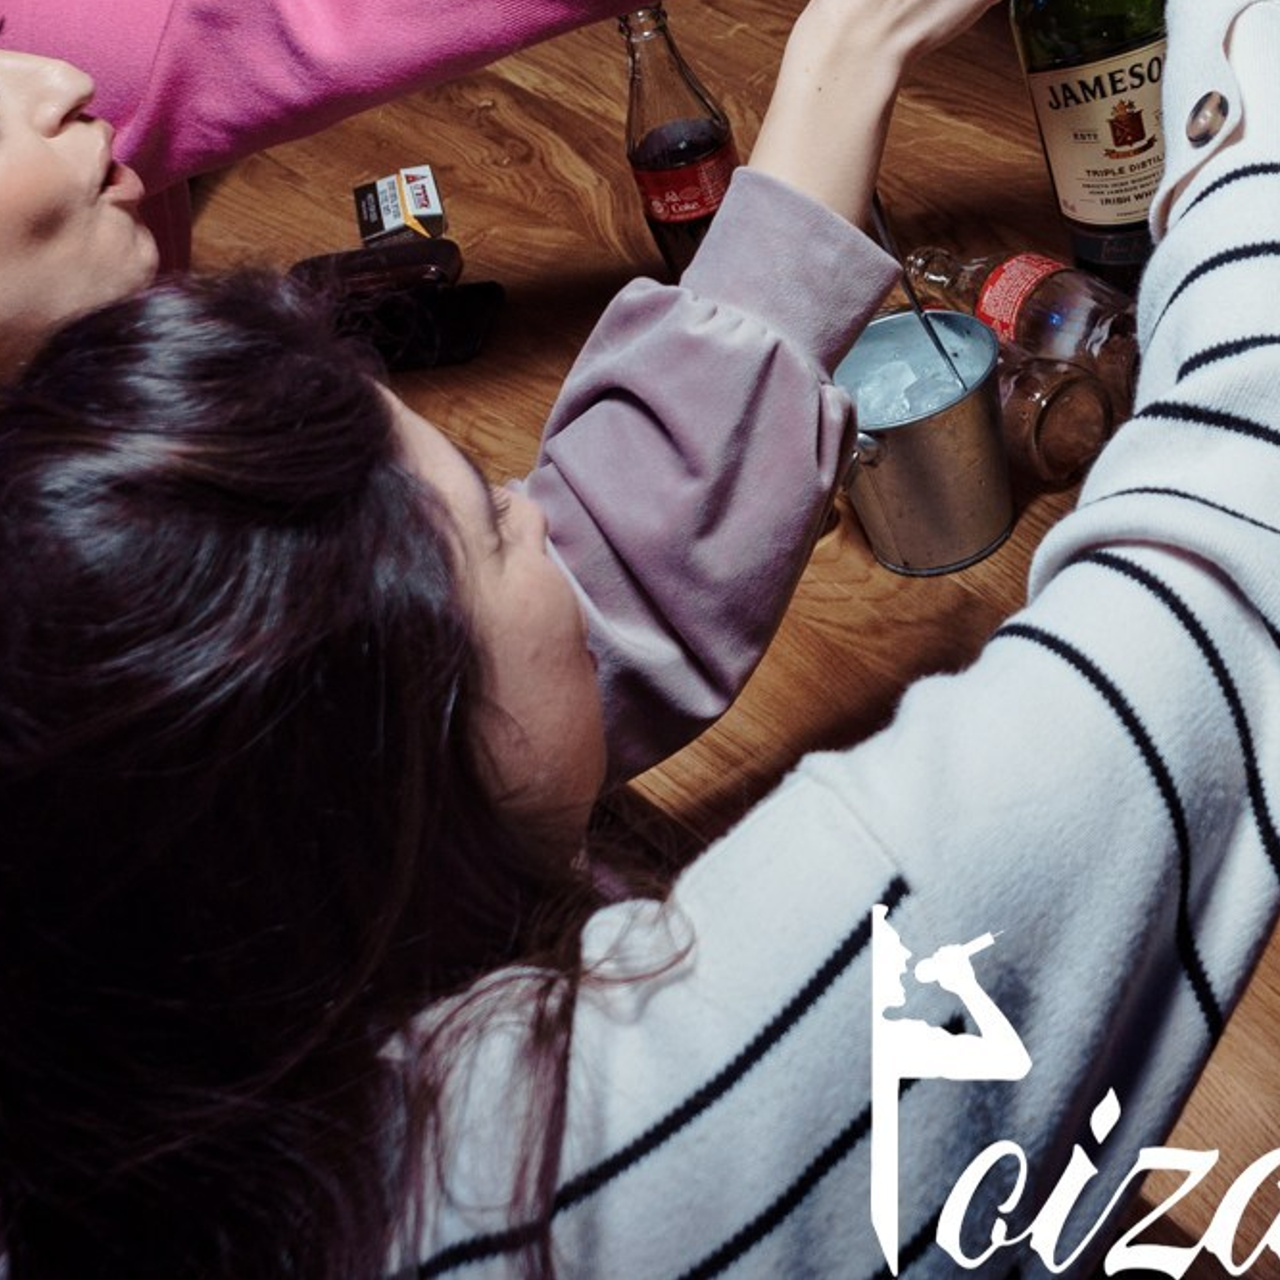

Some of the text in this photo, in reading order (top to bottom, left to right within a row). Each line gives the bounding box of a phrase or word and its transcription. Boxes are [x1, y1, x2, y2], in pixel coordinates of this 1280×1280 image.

[1048, 55, 1166, 110] JAMESO
[1085, 166, 1125, 178] TRIPLE
[1129, 154, 1164, 172] DISTIL
[1100, 194, 1131, 207] IRISH
